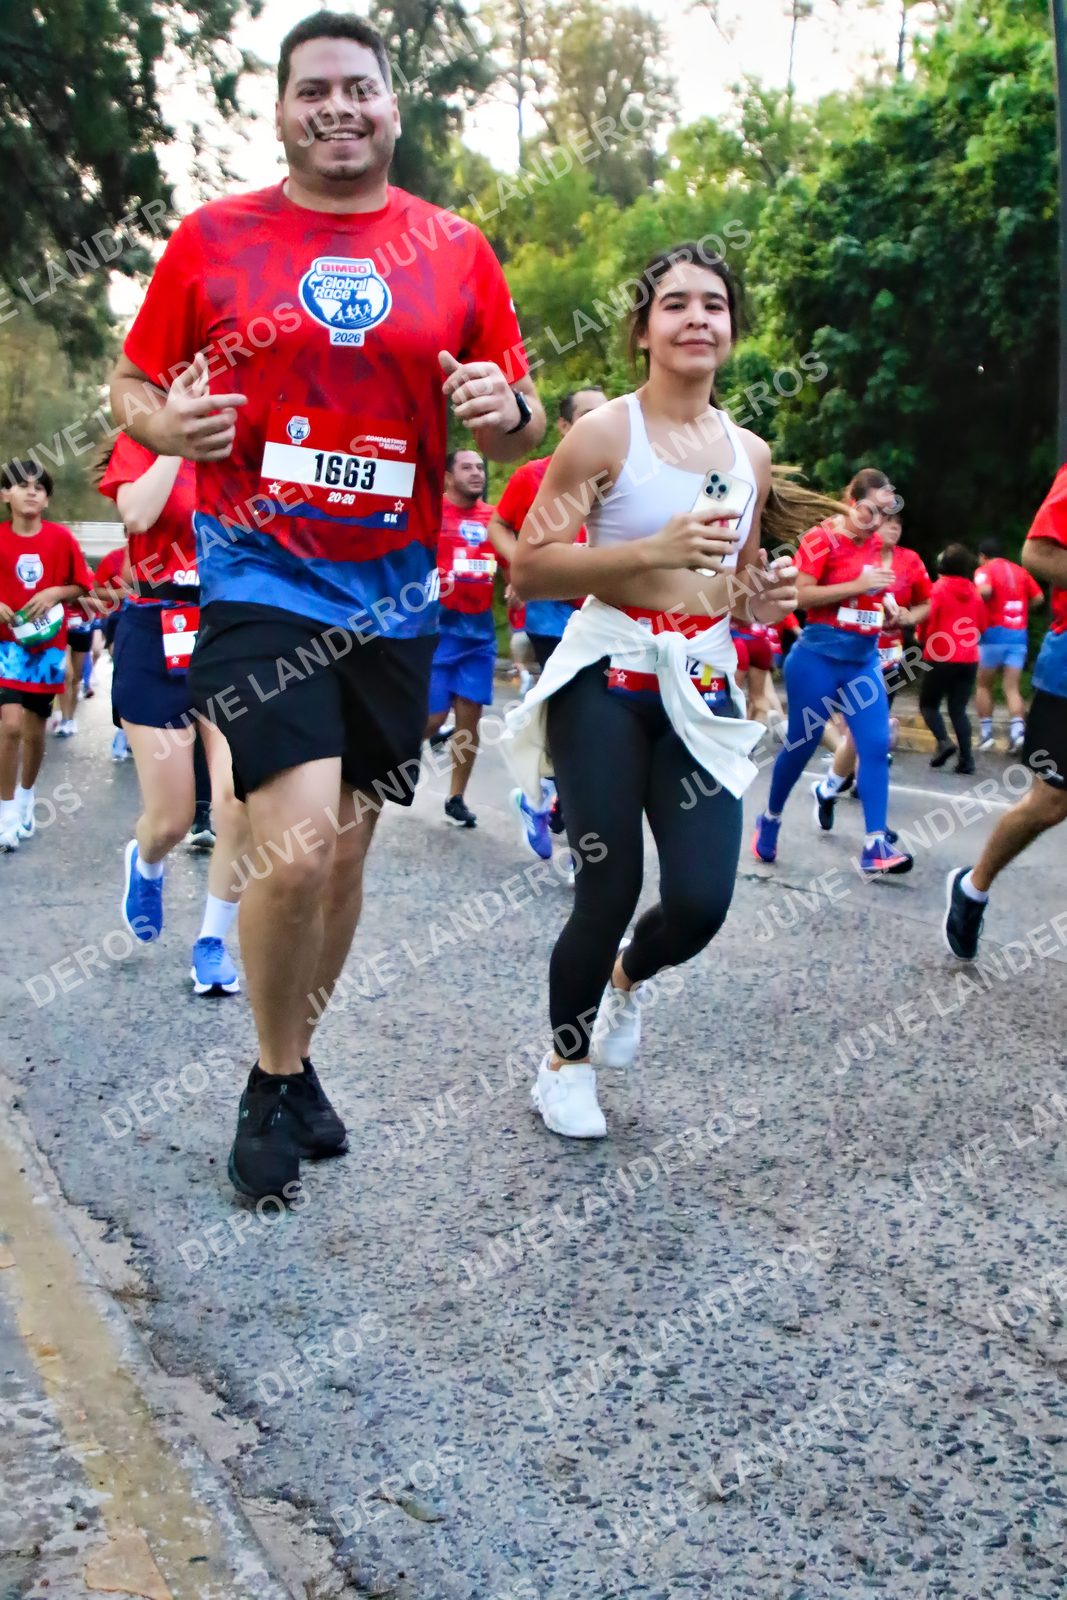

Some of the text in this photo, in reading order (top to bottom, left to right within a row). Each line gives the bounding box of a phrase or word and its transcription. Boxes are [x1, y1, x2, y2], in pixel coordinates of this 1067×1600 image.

[321, 264, 367, 273] BIMBO
[322, 276, 369, 290] Global
[313, 286, 351, 300] Race
[333, 332, 361, 343] 2026
[314, 453, 376, 490] 1663
[384, 513, 398, 523] 5K
[173, 570, 200, 586] SA
